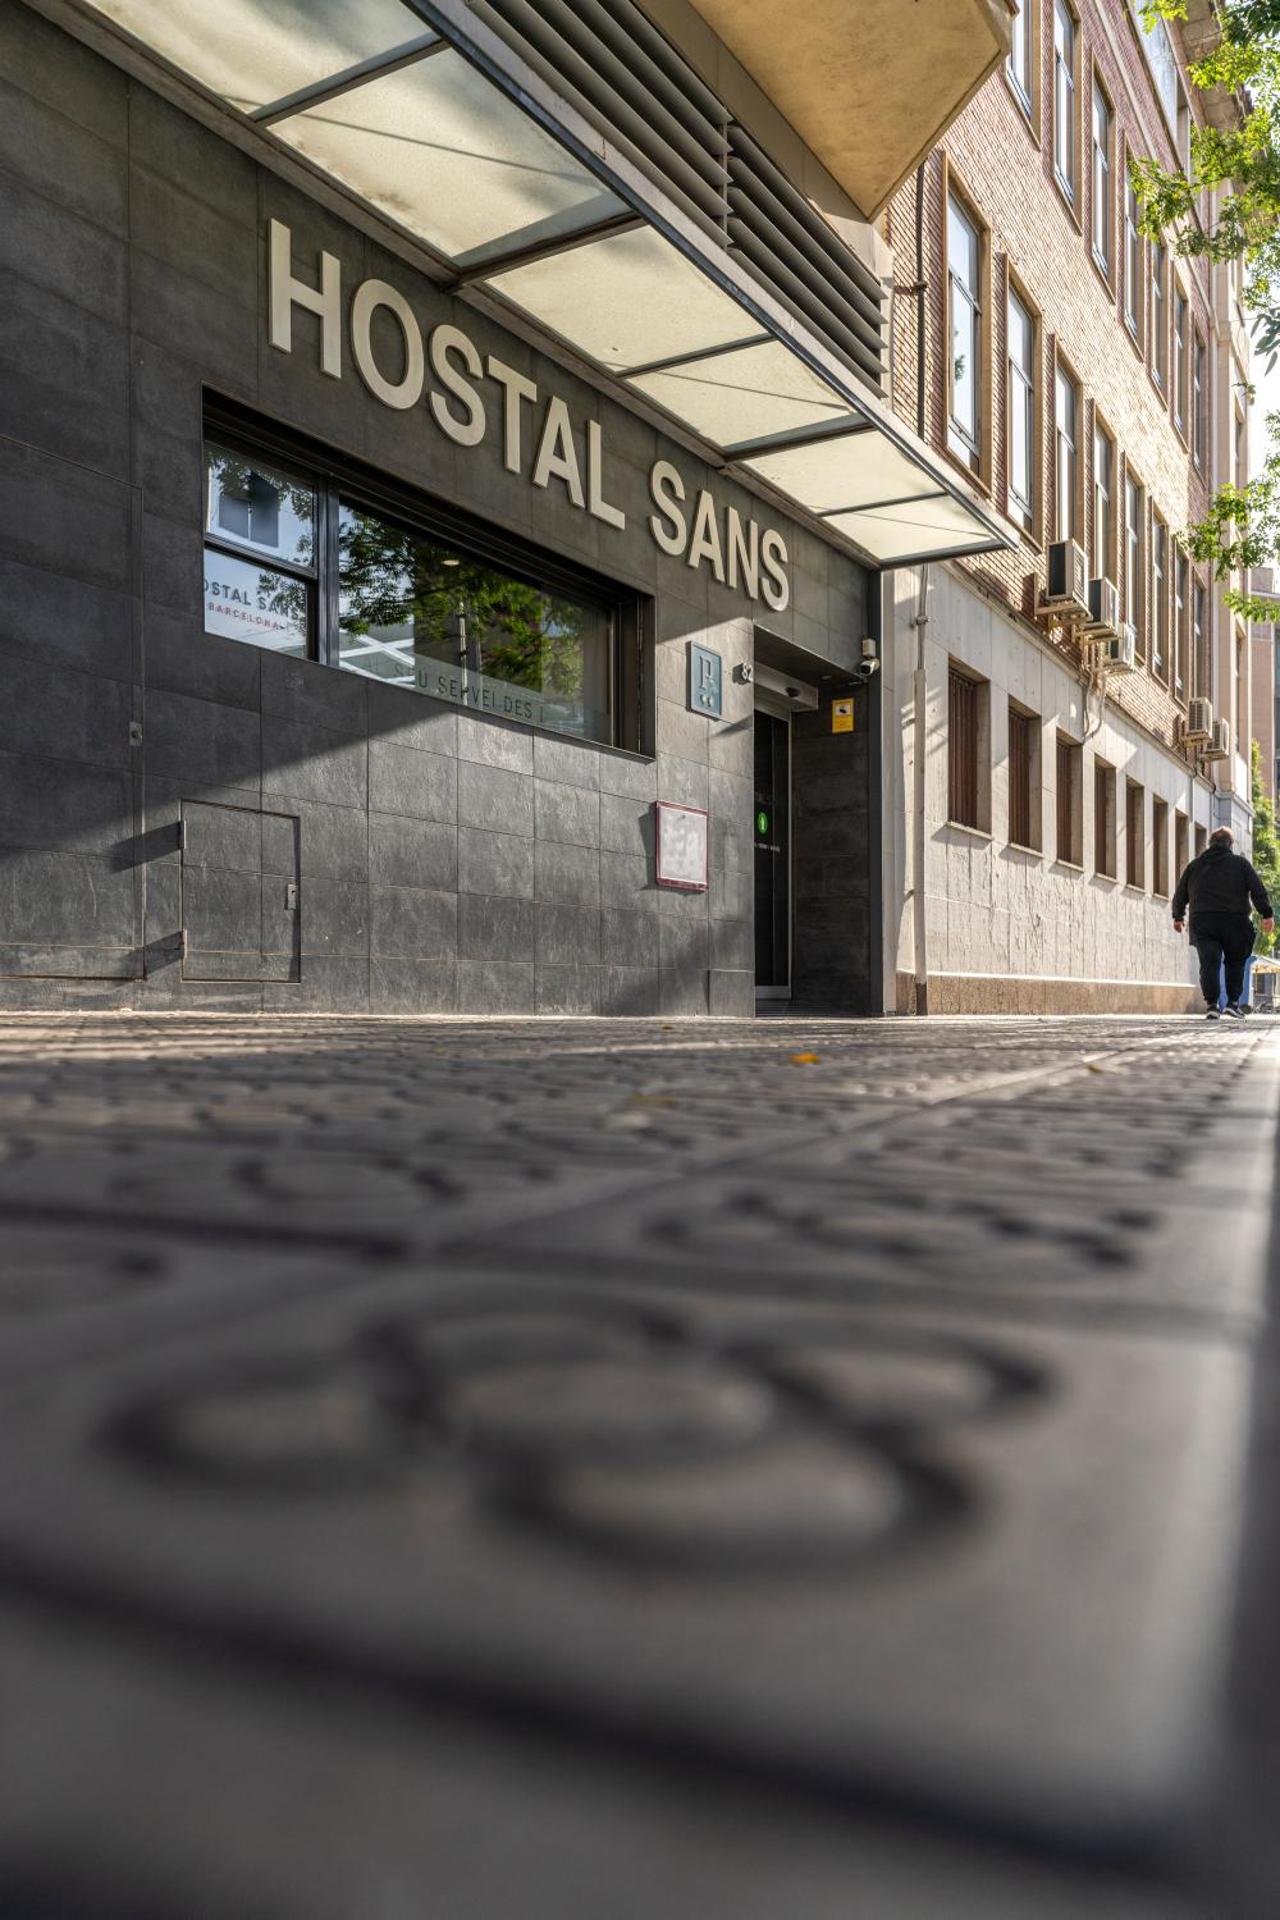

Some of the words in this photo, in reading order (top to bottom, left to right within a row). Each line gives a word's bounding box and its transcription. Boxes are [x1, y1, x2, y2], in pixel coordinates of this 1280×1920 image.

[269, 218, 625, 531] HOSTAL
[649, 460, 790, 612] SANS
[203, 579, 251, 606] OSTAL
[257, 597, 299, 620] SANS
[208, 602, 280, 629] BARCELONA
[438, 675, 496, 708] SERVEI
[504, 695, 533, 720] DES
